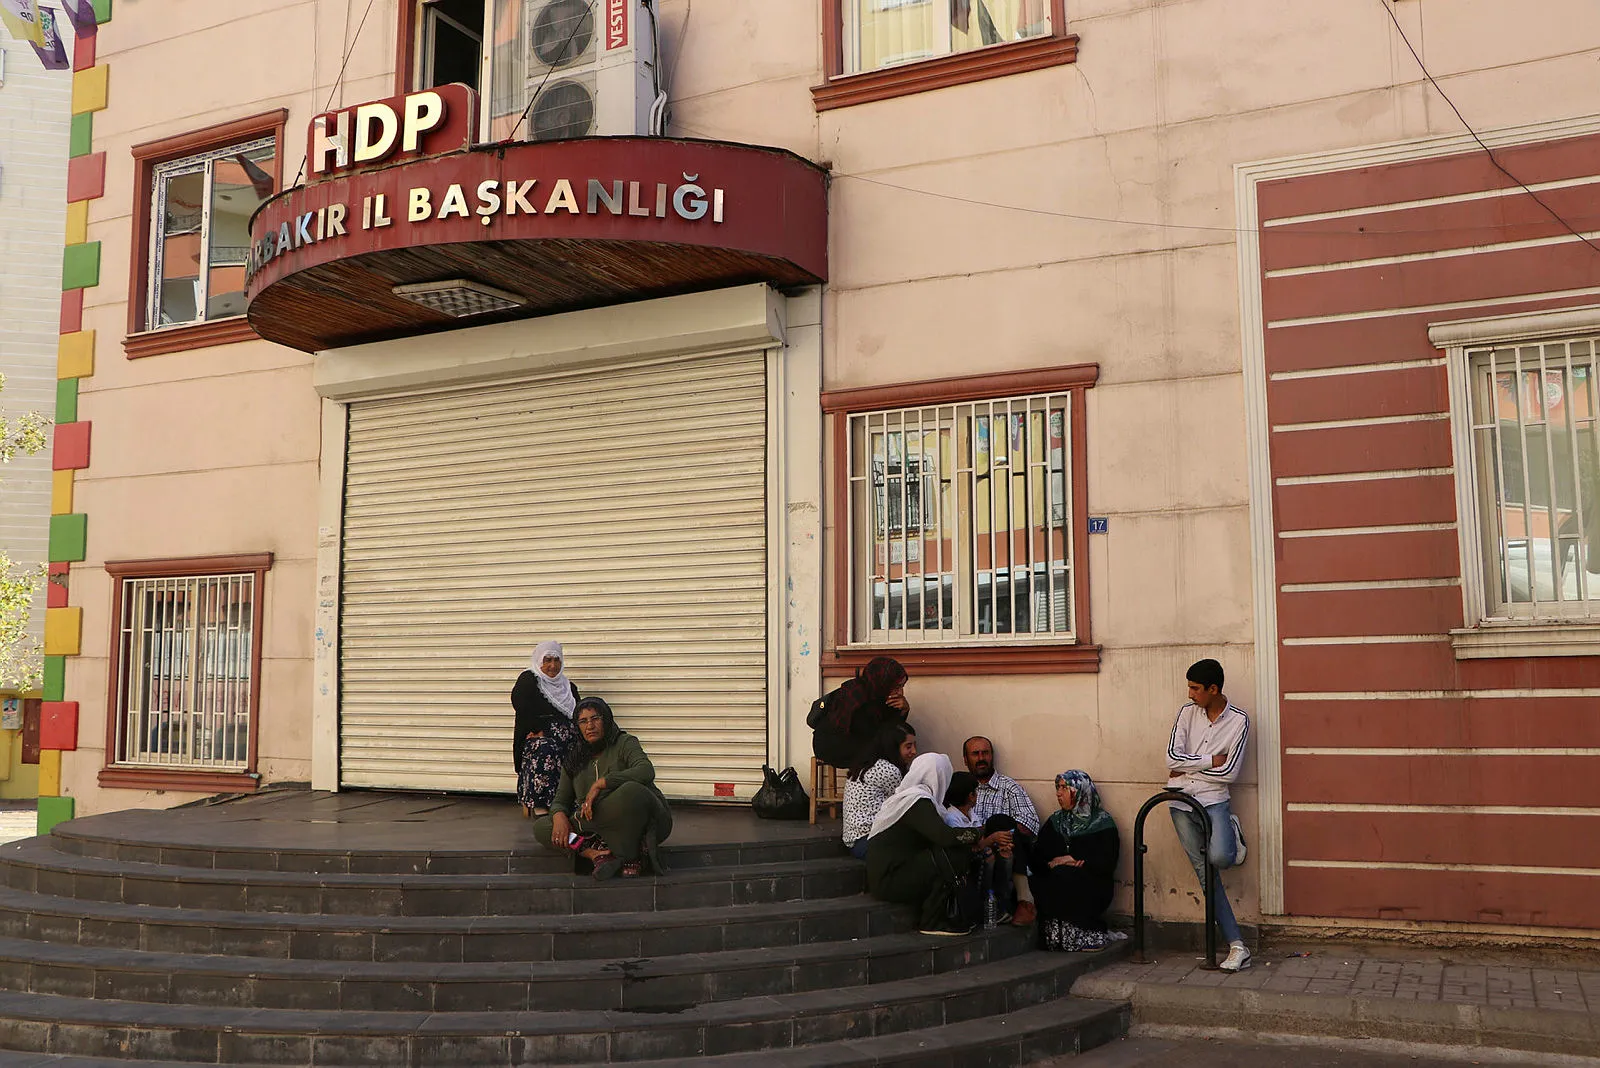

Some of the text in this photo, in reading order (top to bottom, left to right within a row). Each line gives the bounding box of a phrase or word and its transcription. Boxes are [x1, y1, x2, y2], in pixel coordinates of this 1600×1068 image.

[610, 0, 623, 49] VESTE
[313, 91, 444, 173] HDP
[408, 171, 724, 226] BAŞKANLIĞI
[1092, 520, 1105, 530] 17
